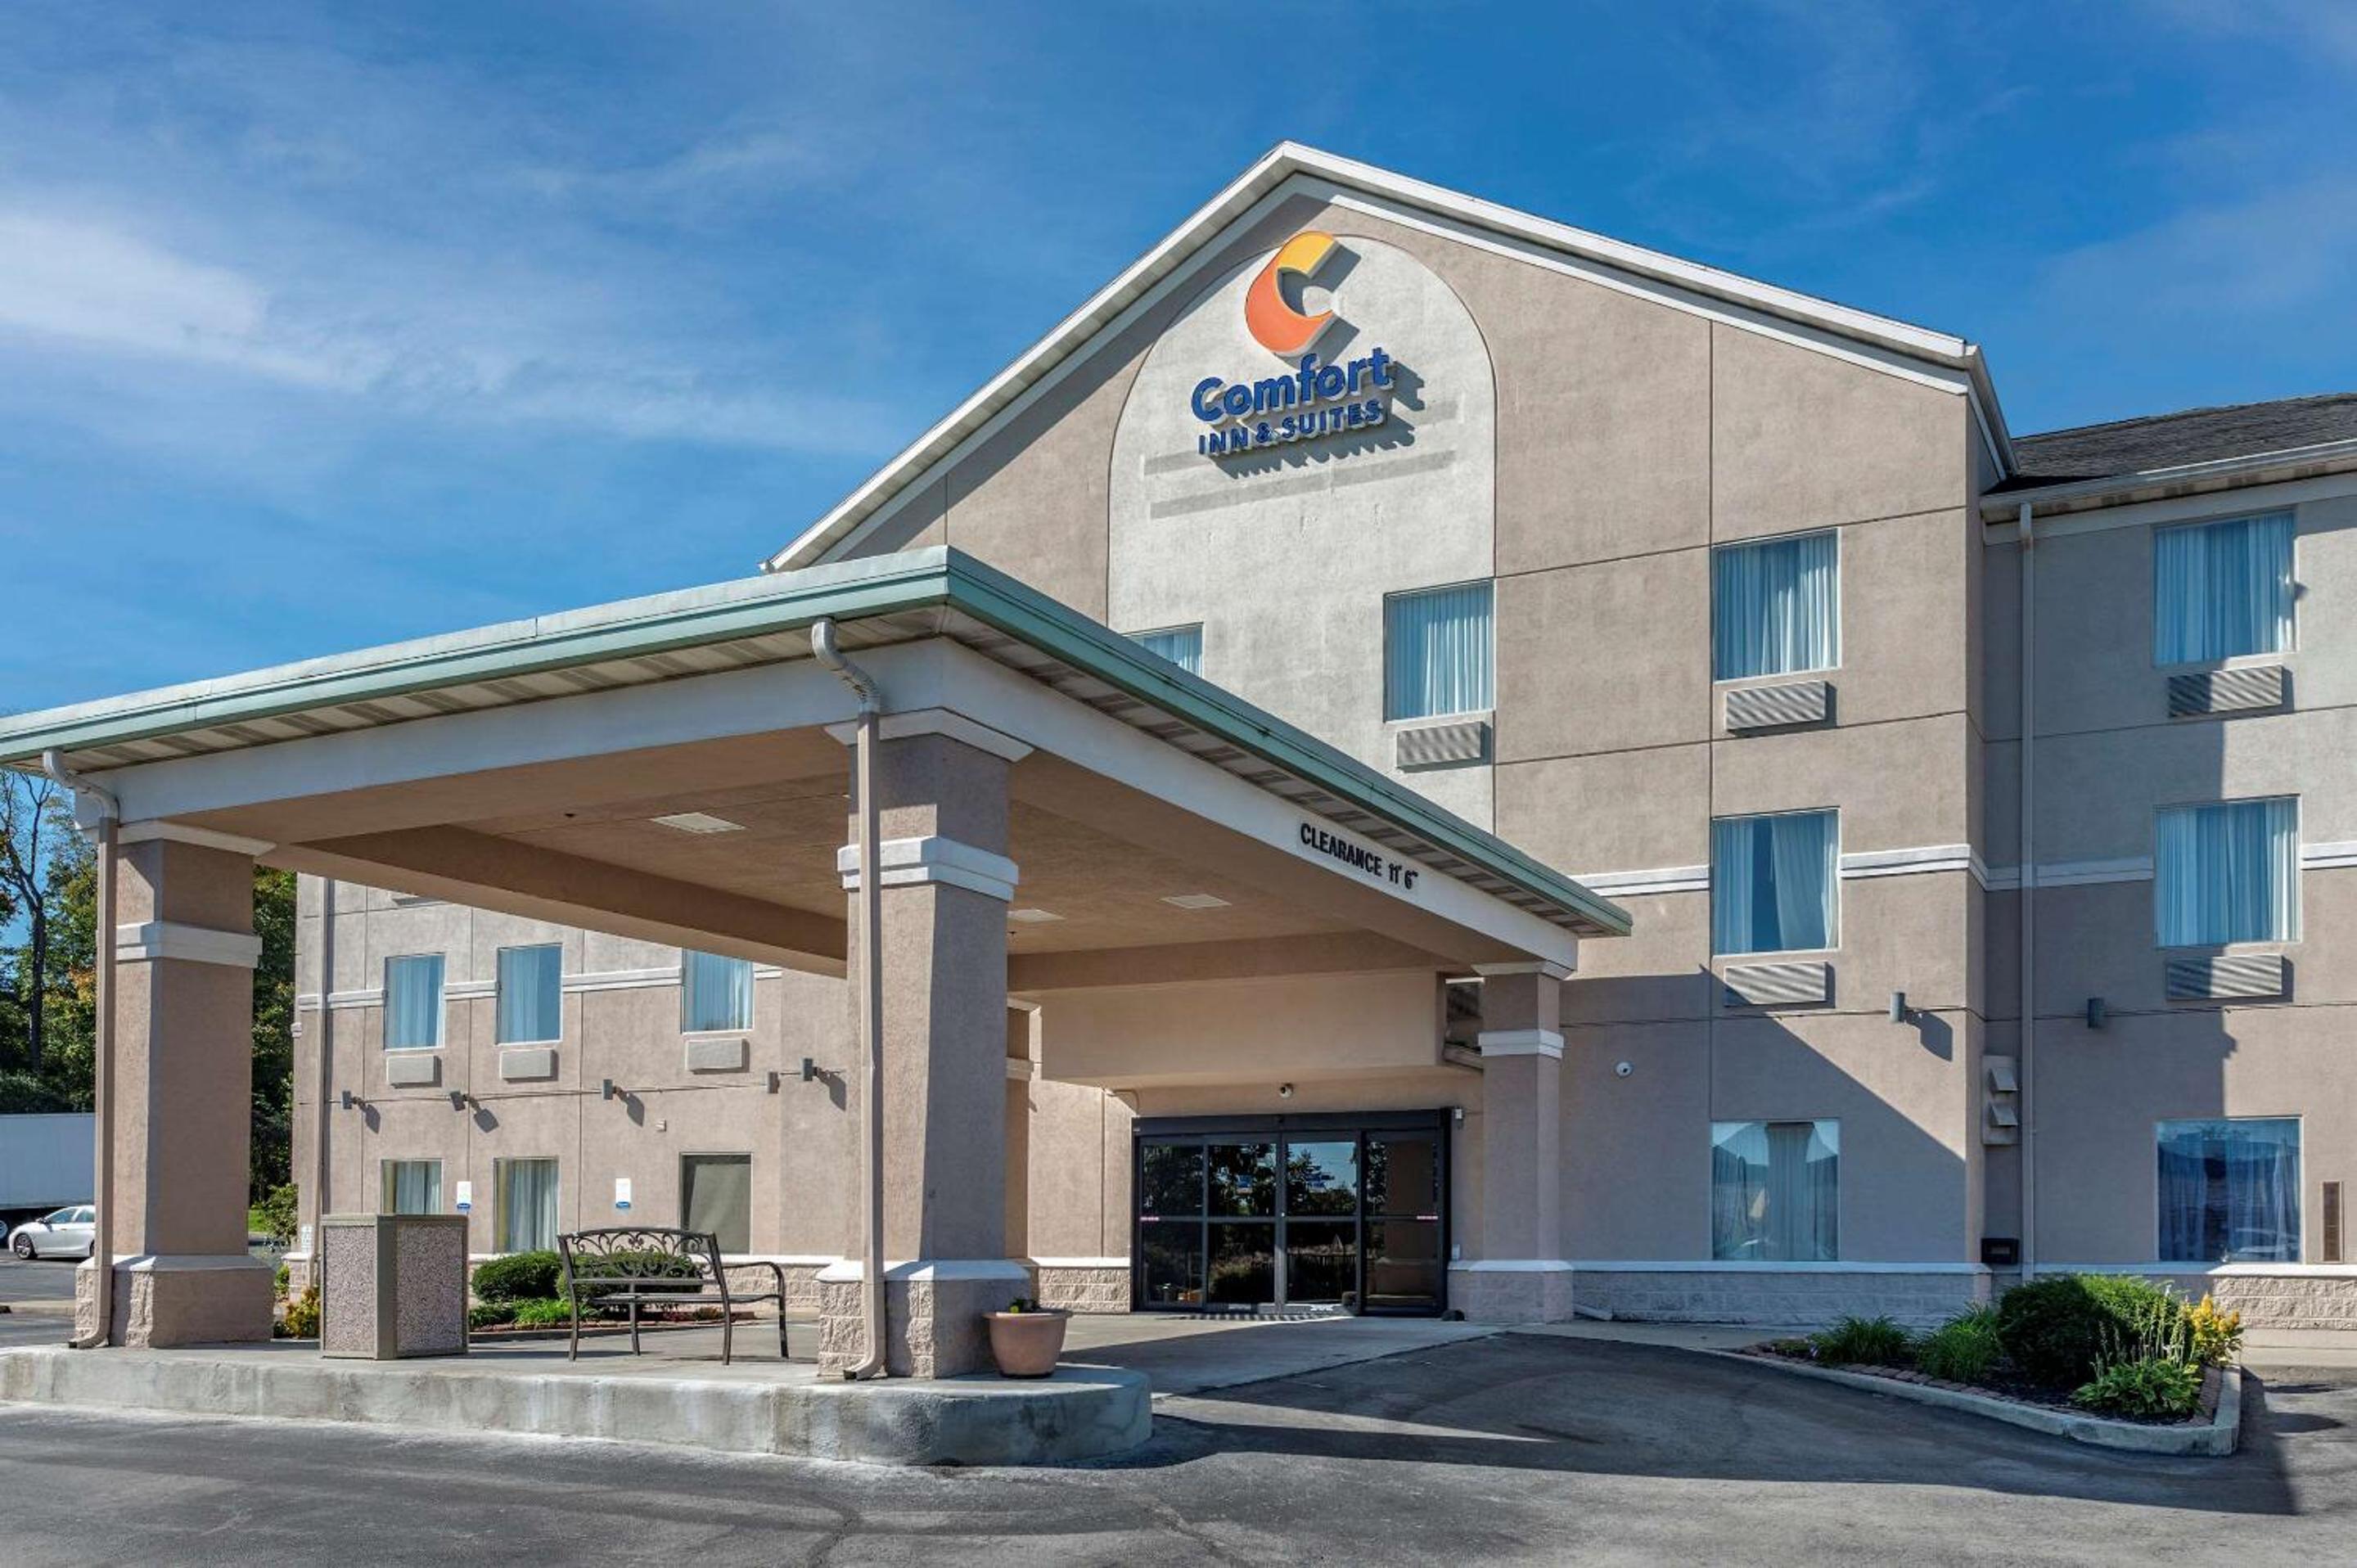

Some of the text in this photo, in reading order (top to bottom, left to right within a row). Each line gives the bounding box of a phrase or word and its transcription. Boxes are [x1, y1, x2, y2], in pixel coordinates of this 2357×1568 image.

[1191, 346, 1391, 423] Comfort
[1199, 398, 1383, 455] INN & SUITES
[1300, 822, 1383, 877] CLEARANCE
